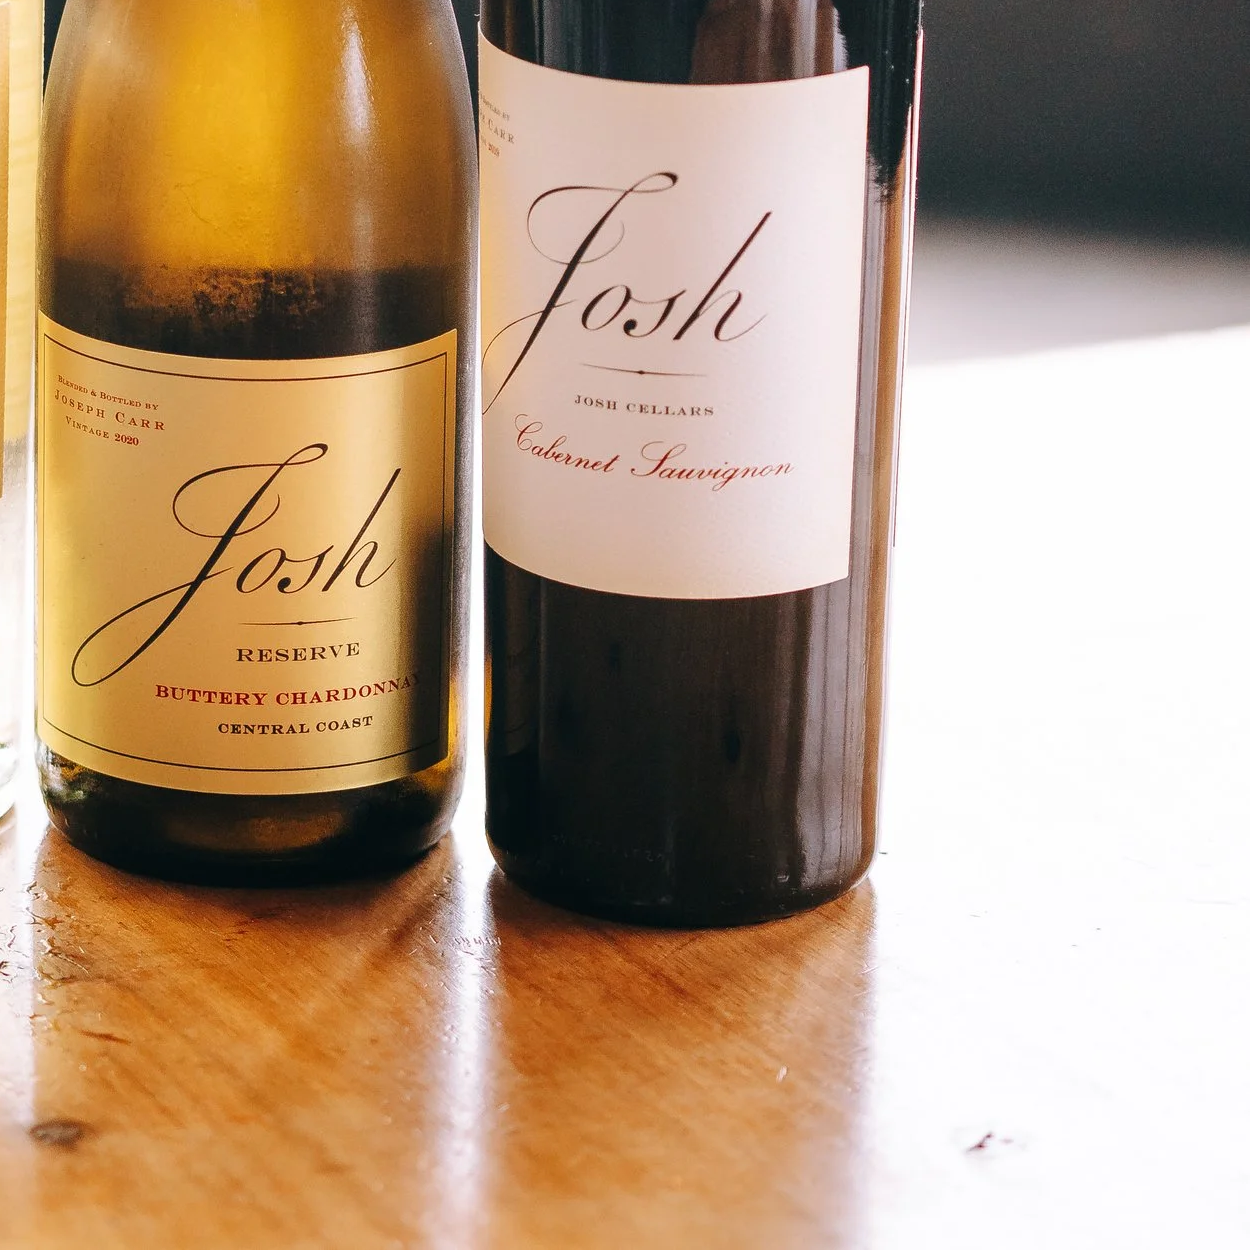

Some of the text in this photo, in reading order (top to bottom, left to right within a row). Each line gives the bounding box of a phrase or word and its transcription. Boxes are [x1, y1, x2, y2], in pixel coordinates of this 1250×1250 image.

[481, 172, 773, 415] Josh
[54, 389, 165, 430] JOSEPH CARR
[57, 375, 159, 411] BLENDED & BOTTLED BY
[574, 394, 715, 416] JOSH CELLARS
[65, 415, 139, 446] VINTAGE 2020
[514, 413, 794, 492] Cabernet Sauvignon
[72, 443, 401, 687] Josh
[236, 642, 360, 662] RESERVE
[155, 684, 268, 706] BUTTERY
[218, 715, 373, 735] CENTRAL COAST
